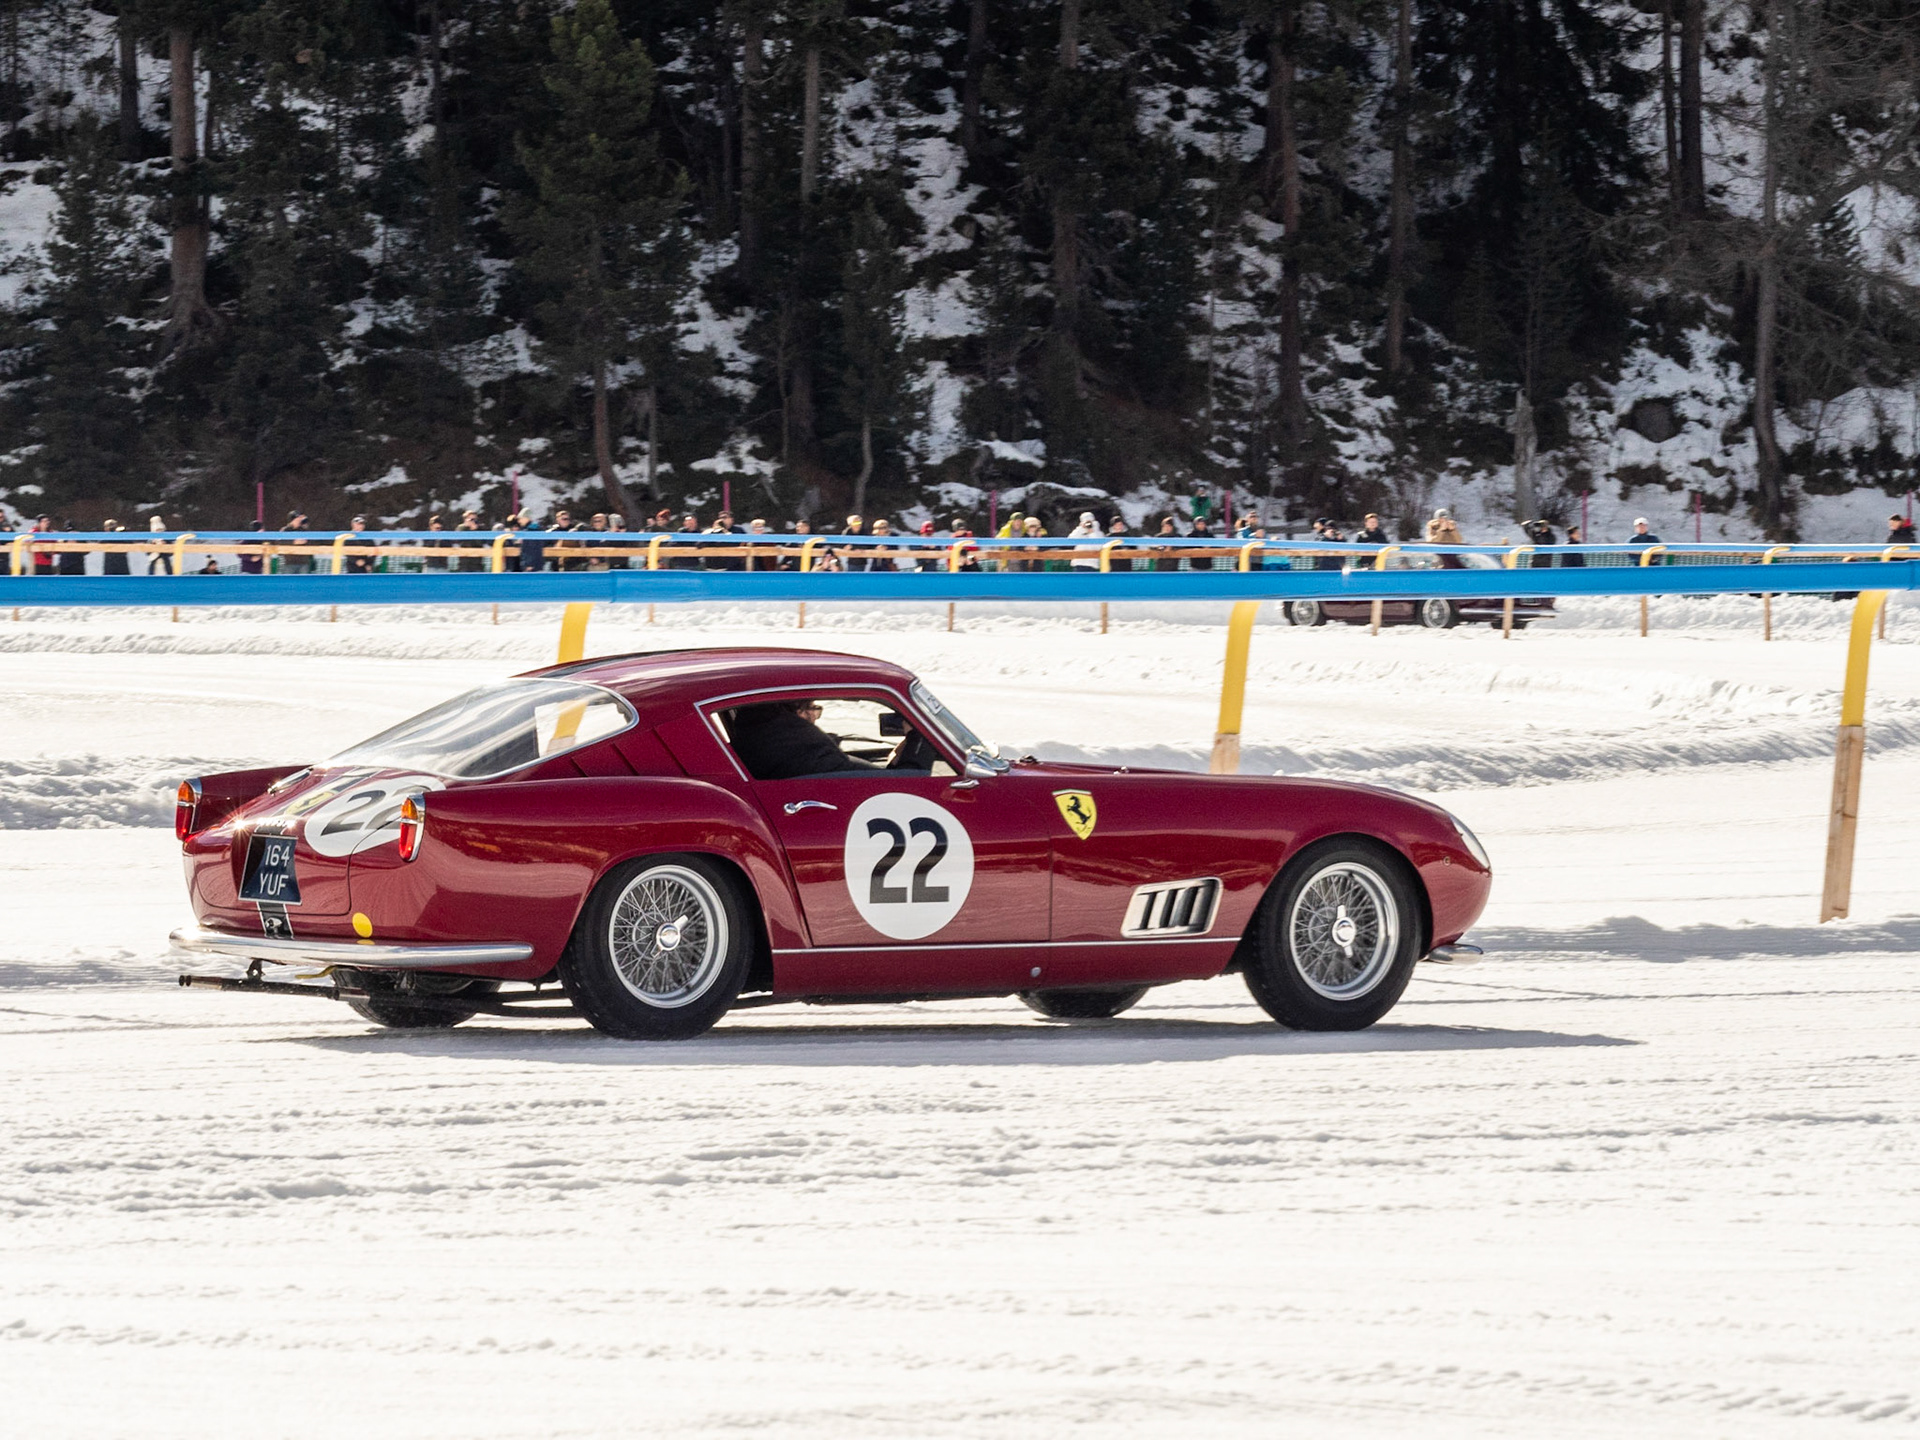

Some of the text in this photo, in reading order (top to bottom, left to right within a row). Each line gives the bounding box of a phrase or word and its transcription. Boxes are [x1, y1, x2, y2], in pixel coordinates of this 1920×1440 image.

[265, 844, 290, 868] 164
[866, 816, 950, 904] 22
[259, 873, 289, 896] YUF
